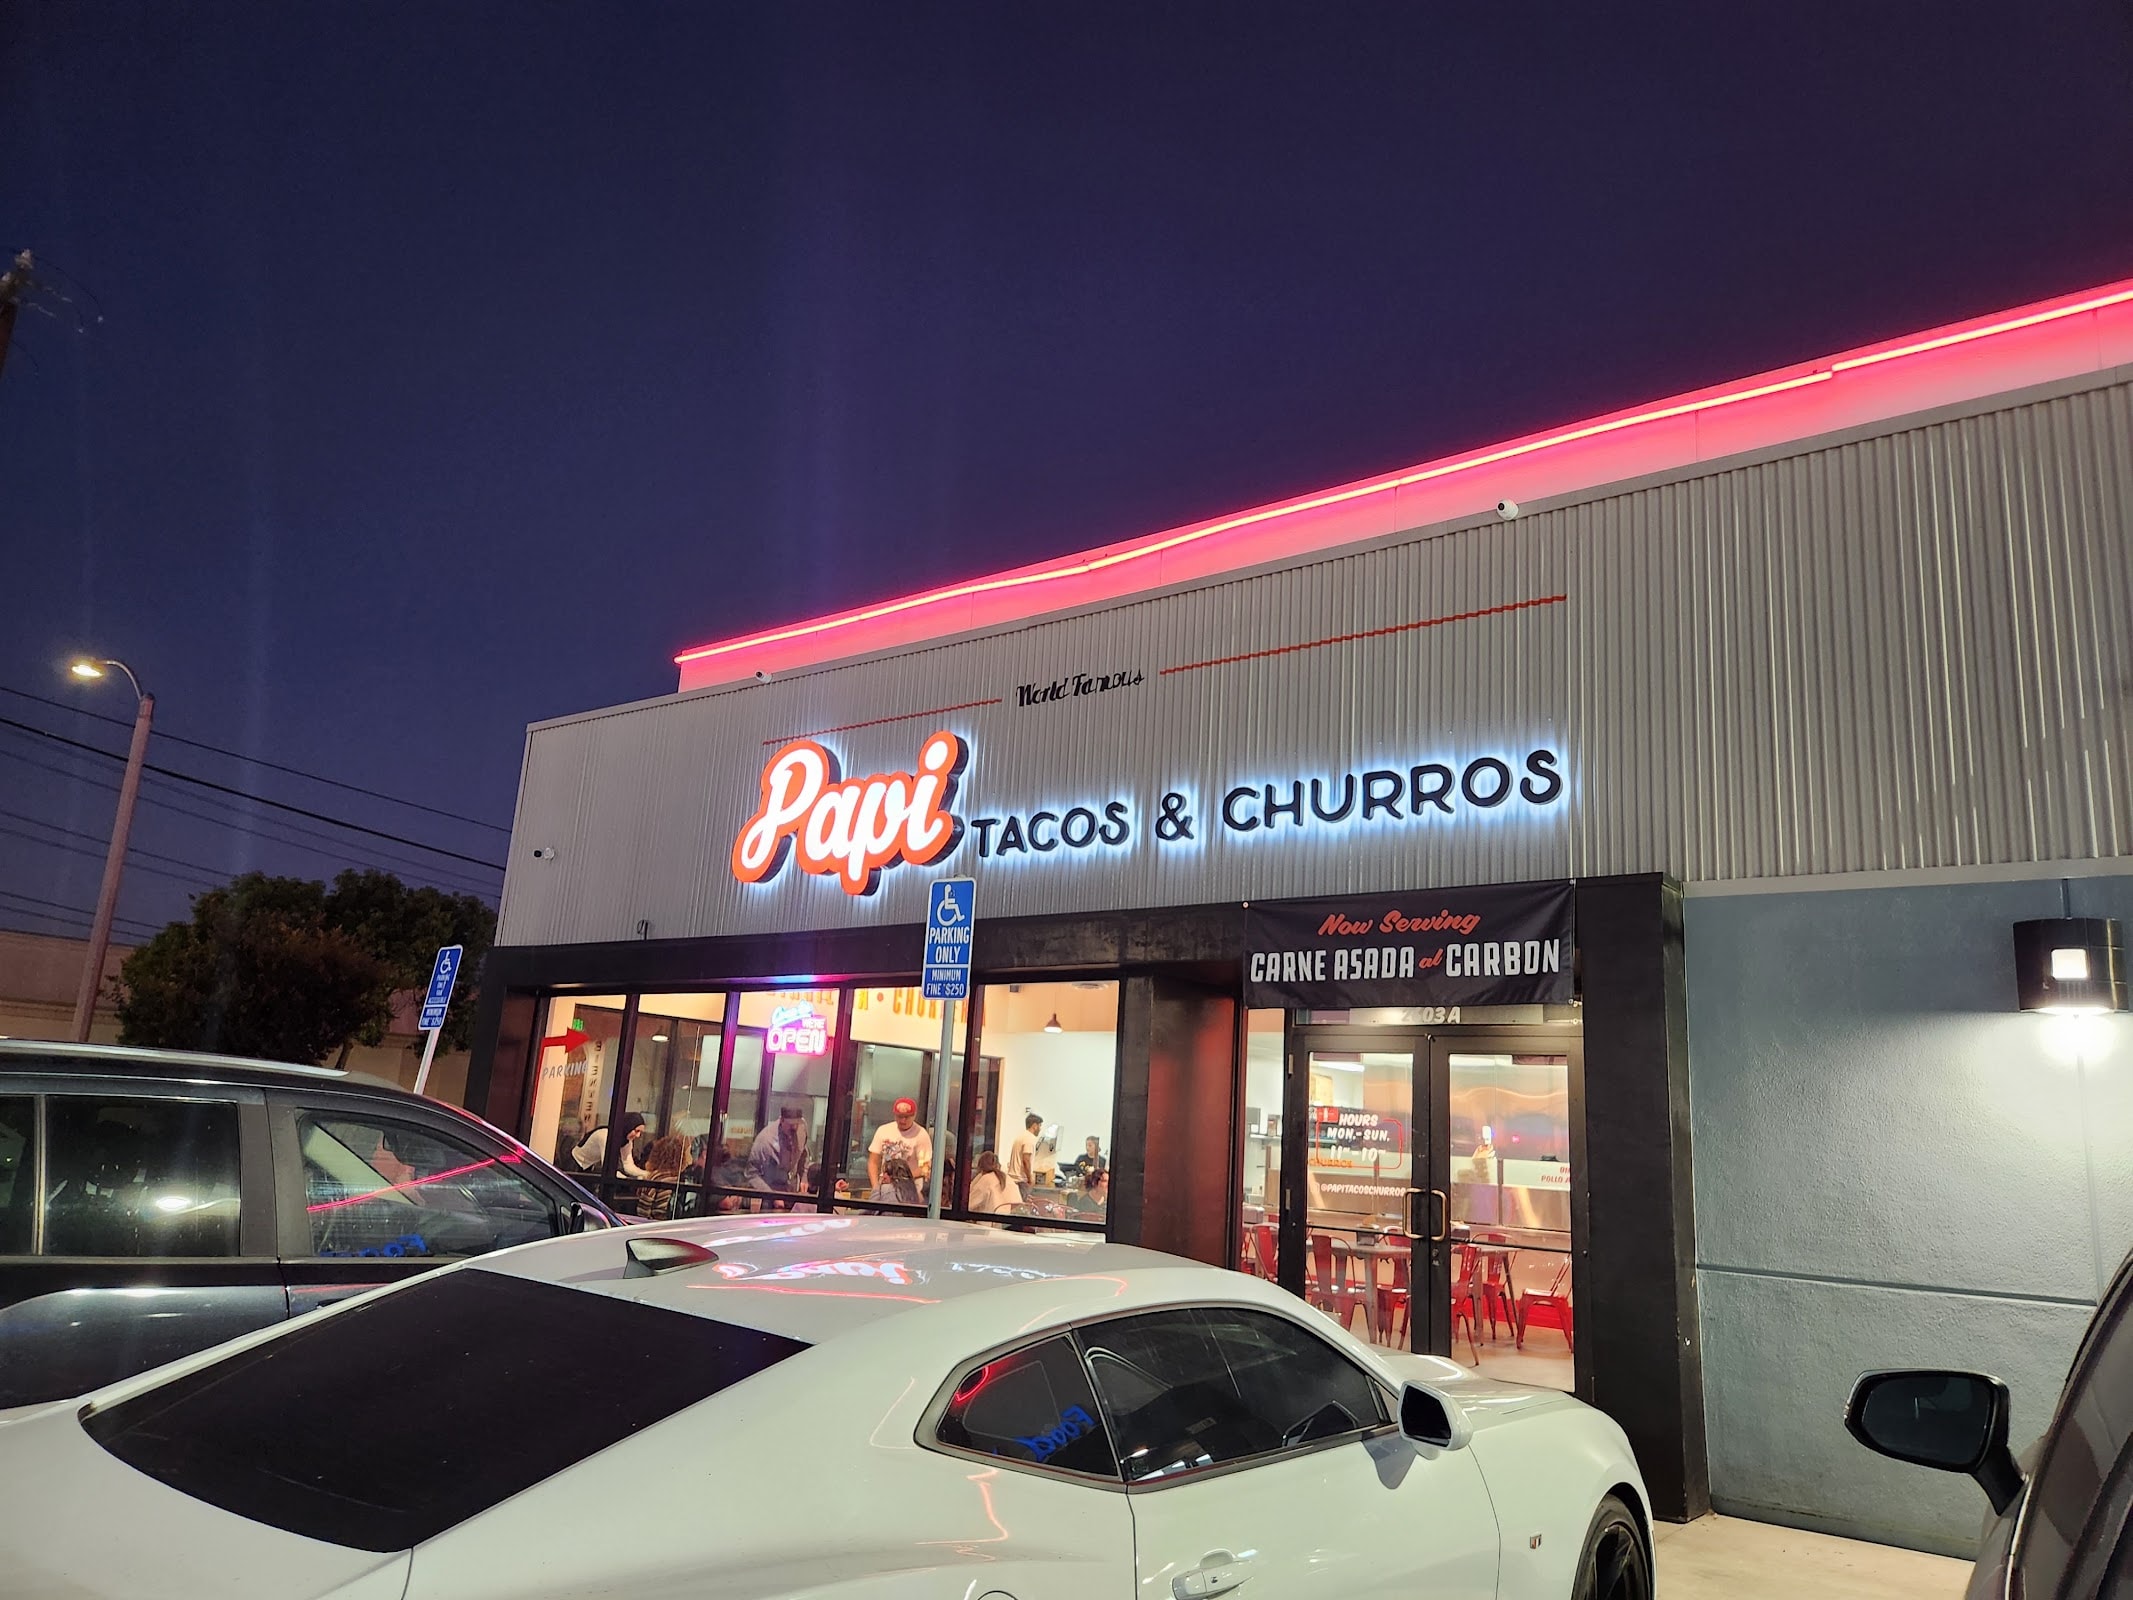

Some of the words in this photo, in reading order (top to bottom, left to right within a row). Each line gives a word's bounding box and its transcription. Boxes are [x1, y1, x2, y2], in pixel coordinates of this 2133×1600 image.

[1016, 678, 1070, 707] World
[1072, 669, 1144, 697] Famous
[732, 731, 954, 896] Papi
[971, 801, 1128, 858] TACOS
[1155, 792, 1194, 841] &
[1222, 749, 1562, 832] CHURROS
[929, 926, 970, 944] PARKING
[1318, 914, 1373, 935] Now
[1379, 909, 1481, 934] Serving
[935, 946, 961, 963] ONLY
[1250, 950, 1327, 983] CARNE
[1333, 946, 1415, 980] ASADA
[1418, 948, 1443, 969] al
[1445, 938, 1560, 977] CARBON
[931, 969, 962, 982] MINIMUM
[926, 983, 941, 996] FINE
[944, 983, 965, 996] $250
[768, 1028, 826, 1054] OPEN
[1338, 1113, 1378, 1127] HOURS
